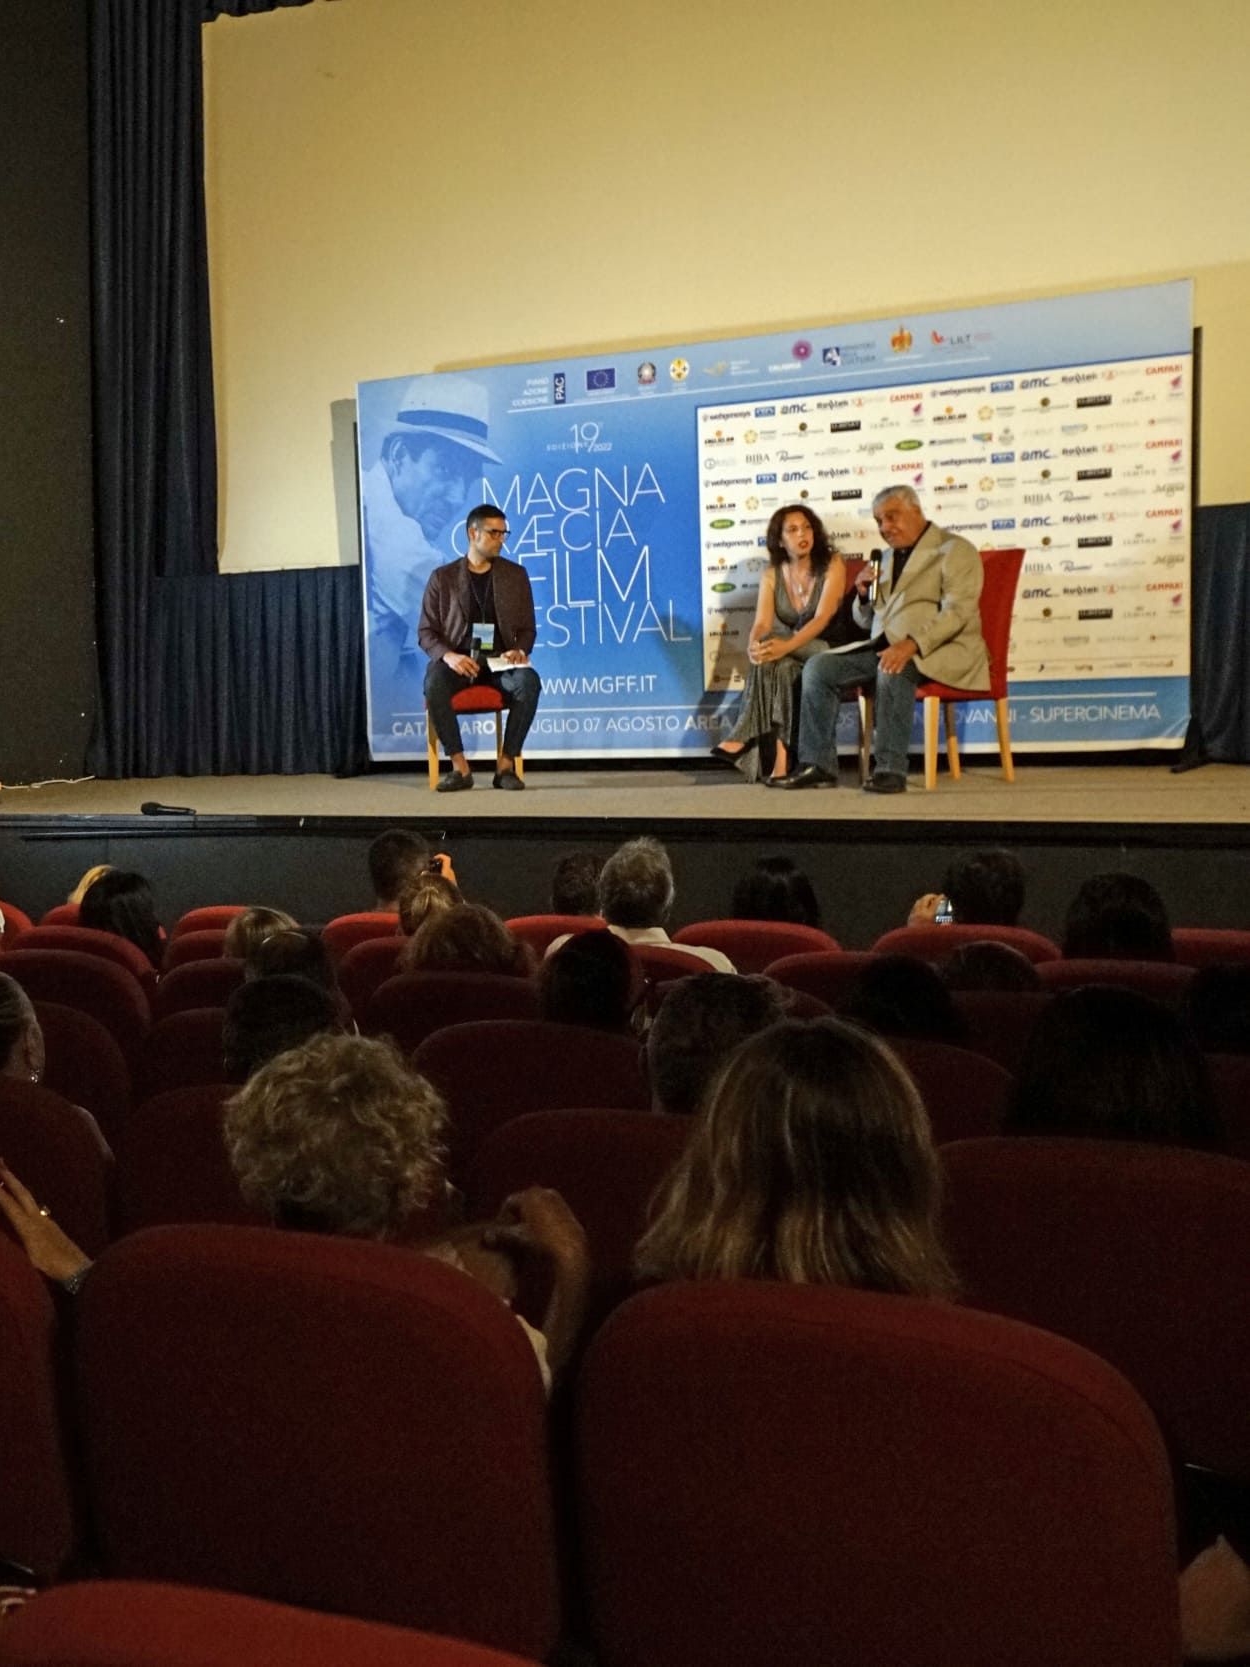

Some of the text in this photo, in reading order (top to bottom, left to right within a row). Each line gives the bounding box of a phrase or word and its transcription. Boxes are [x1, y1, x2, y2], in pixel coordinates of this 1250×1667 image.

[1145, 364, 1183, 375] CAMPARI
[555, 376, 565, 401] PAC
[890, 392, 923, 403] CAMPARI
[1145, 438, 1183, 449] CAMPARI
[746, 453, 770, 464] BIBA
[891, 462, 924, 473] CAMPARI
[482, 462, 665, 516] MAGNA
[1024, 494, 1052, 505] BIBA
[1145, 508, 1183, 519] CAMPARI
[451, 508, 638, 557] ÆCIA
[1025, 562, 1052, 573] BIBA
[519, 545, 651, 607] FILM
[1145, 582, 1183, 592] CAMPARI
[533, 600, 693, 648] STIVAL
[540, 674, 657, 695] WW.MGFF.IT
[392, 719, 496, 737] CATARO
[529, 719, 580, 734] UGLIO
[583, 718, 600, 732] 07
[606, 715, 680, 732] AGOSTO
[684, 714, 733, 730] AREA
[1030, 704, 1162, 724] SUPERCINEMA
